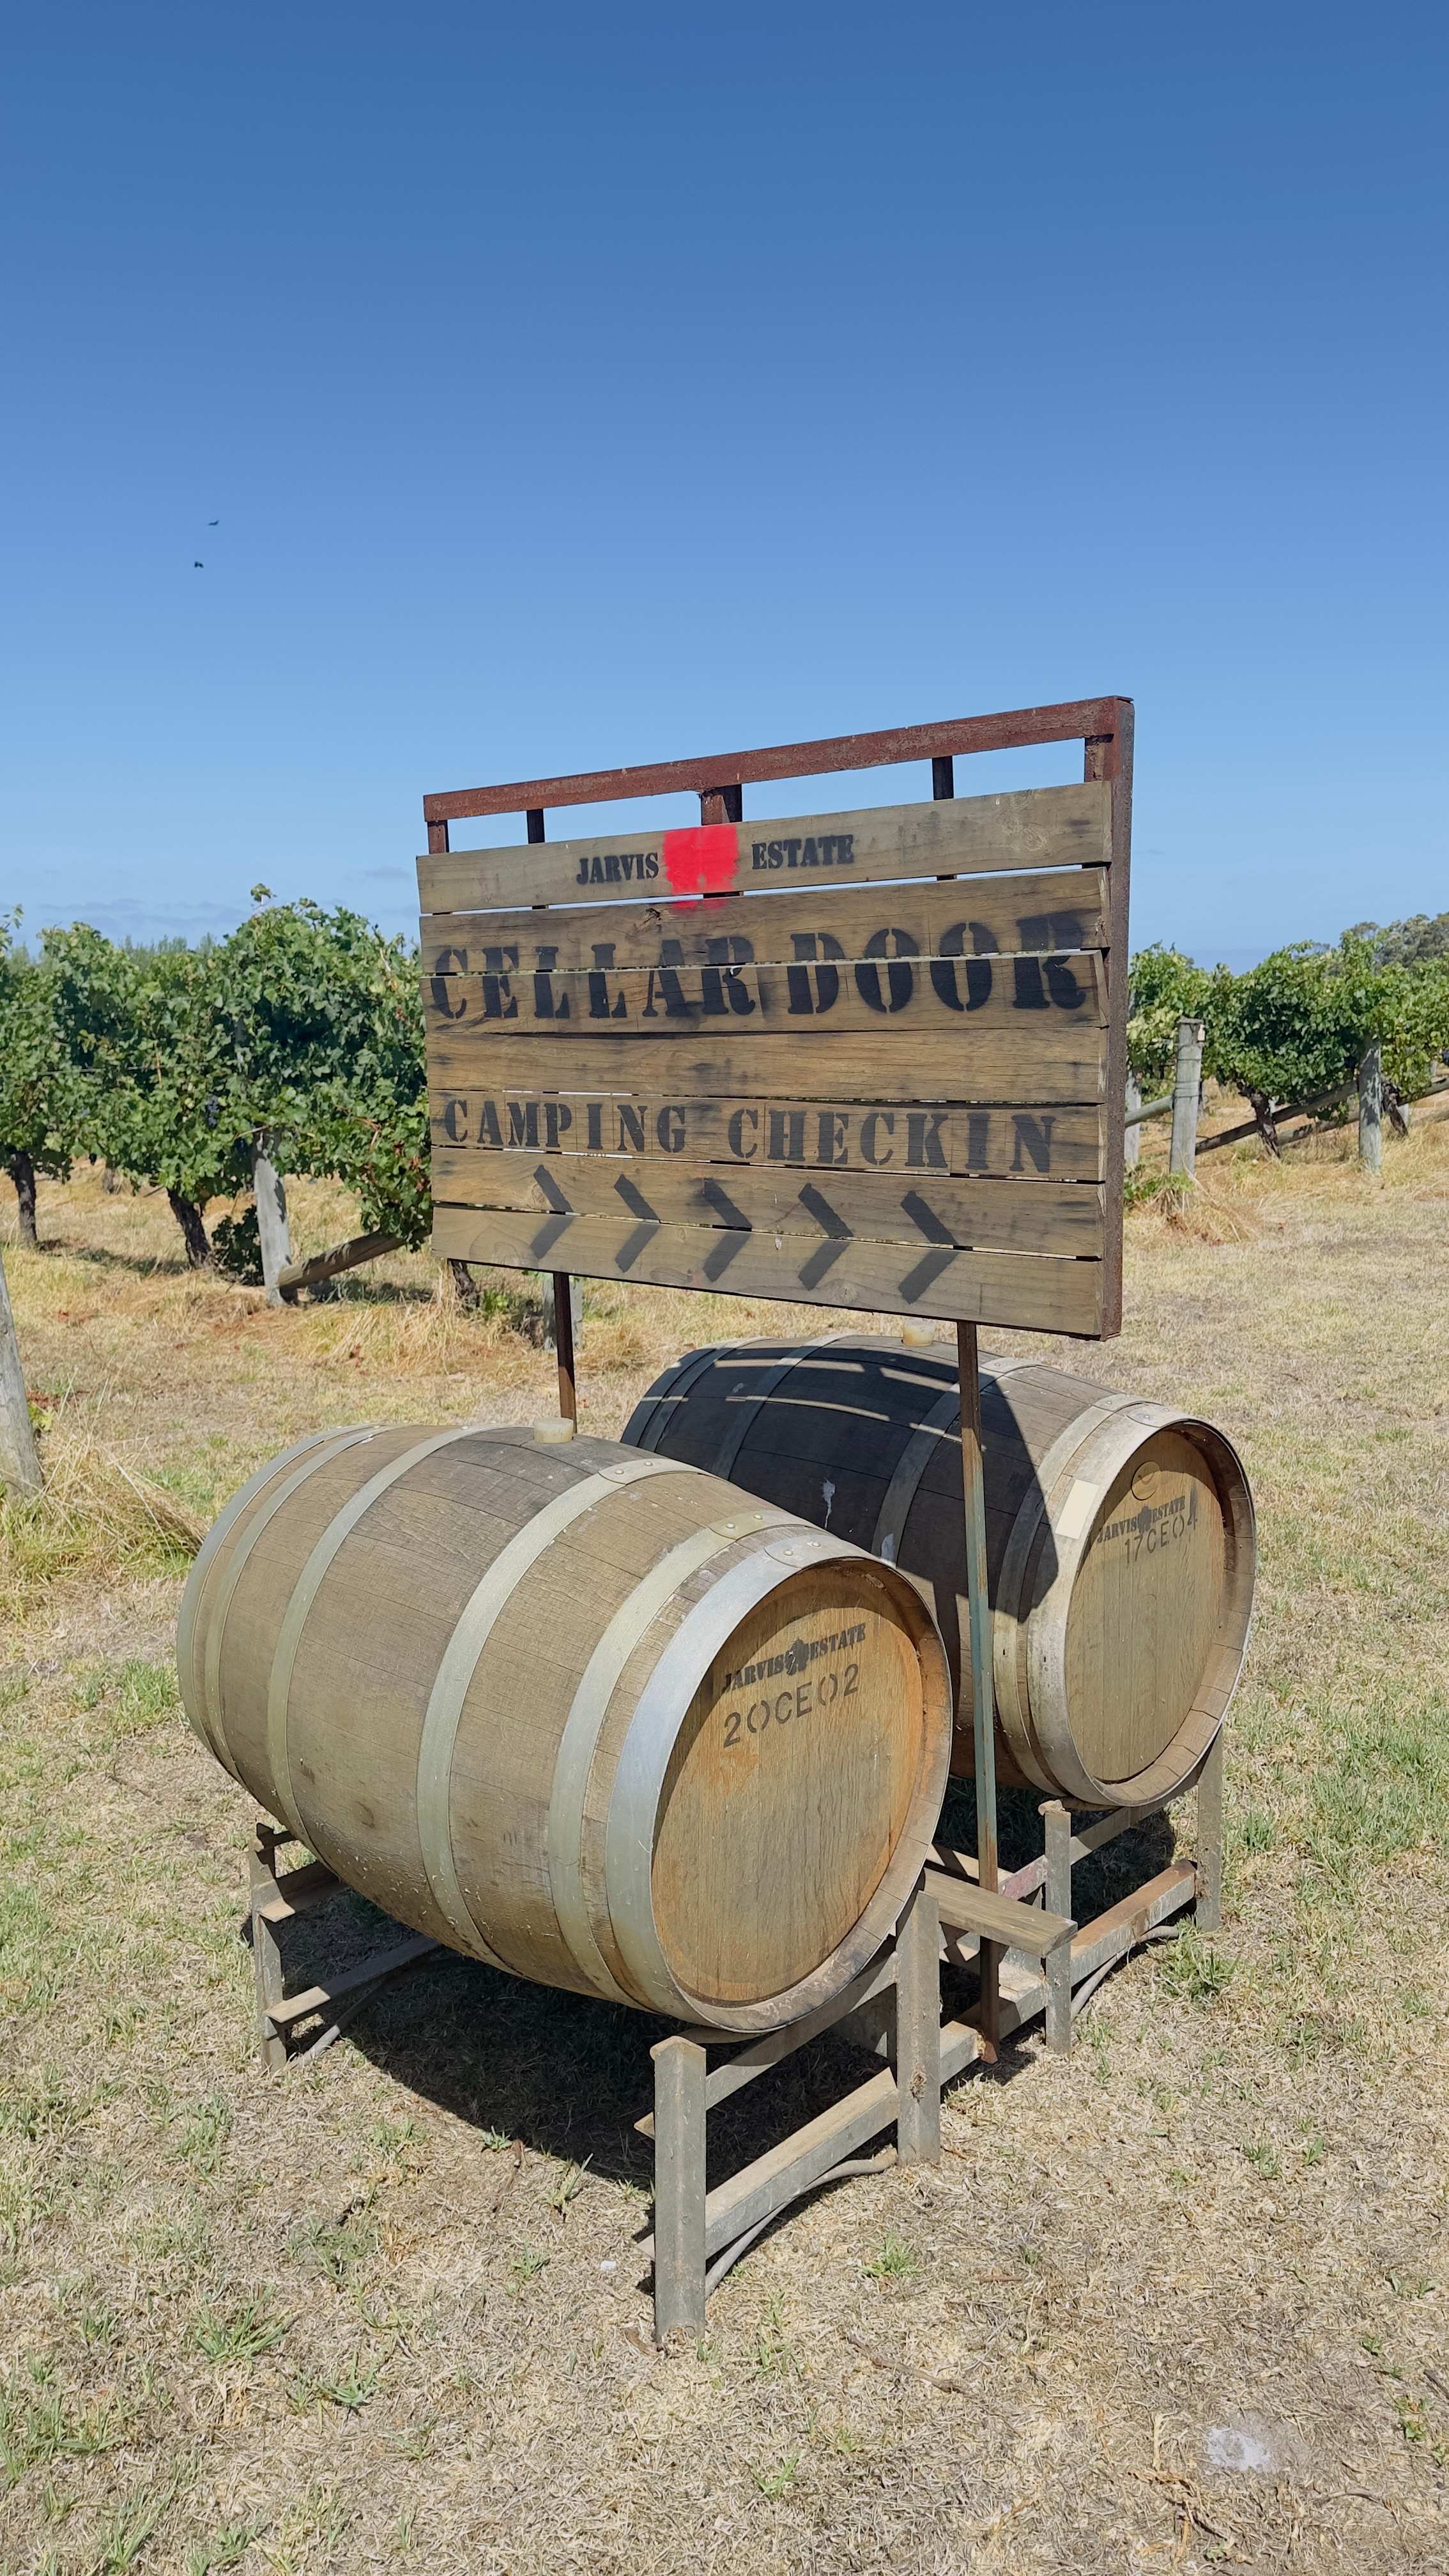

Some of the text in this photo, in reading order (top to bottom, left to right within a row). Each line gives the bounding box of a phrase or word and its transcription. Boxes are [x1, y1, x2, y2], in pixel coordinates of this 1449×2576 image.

[576, 834, 855, 885] JARVIS ESTATE
[430, 912, 1087, 1020] CELLAR DOOR
[445, 1099, 687, 1154] CAMPING
[1097, 1495, 1186, 1544] JARVIS ESTATE
[721, 1622, 866, 1693] JARVIS ESTATE
